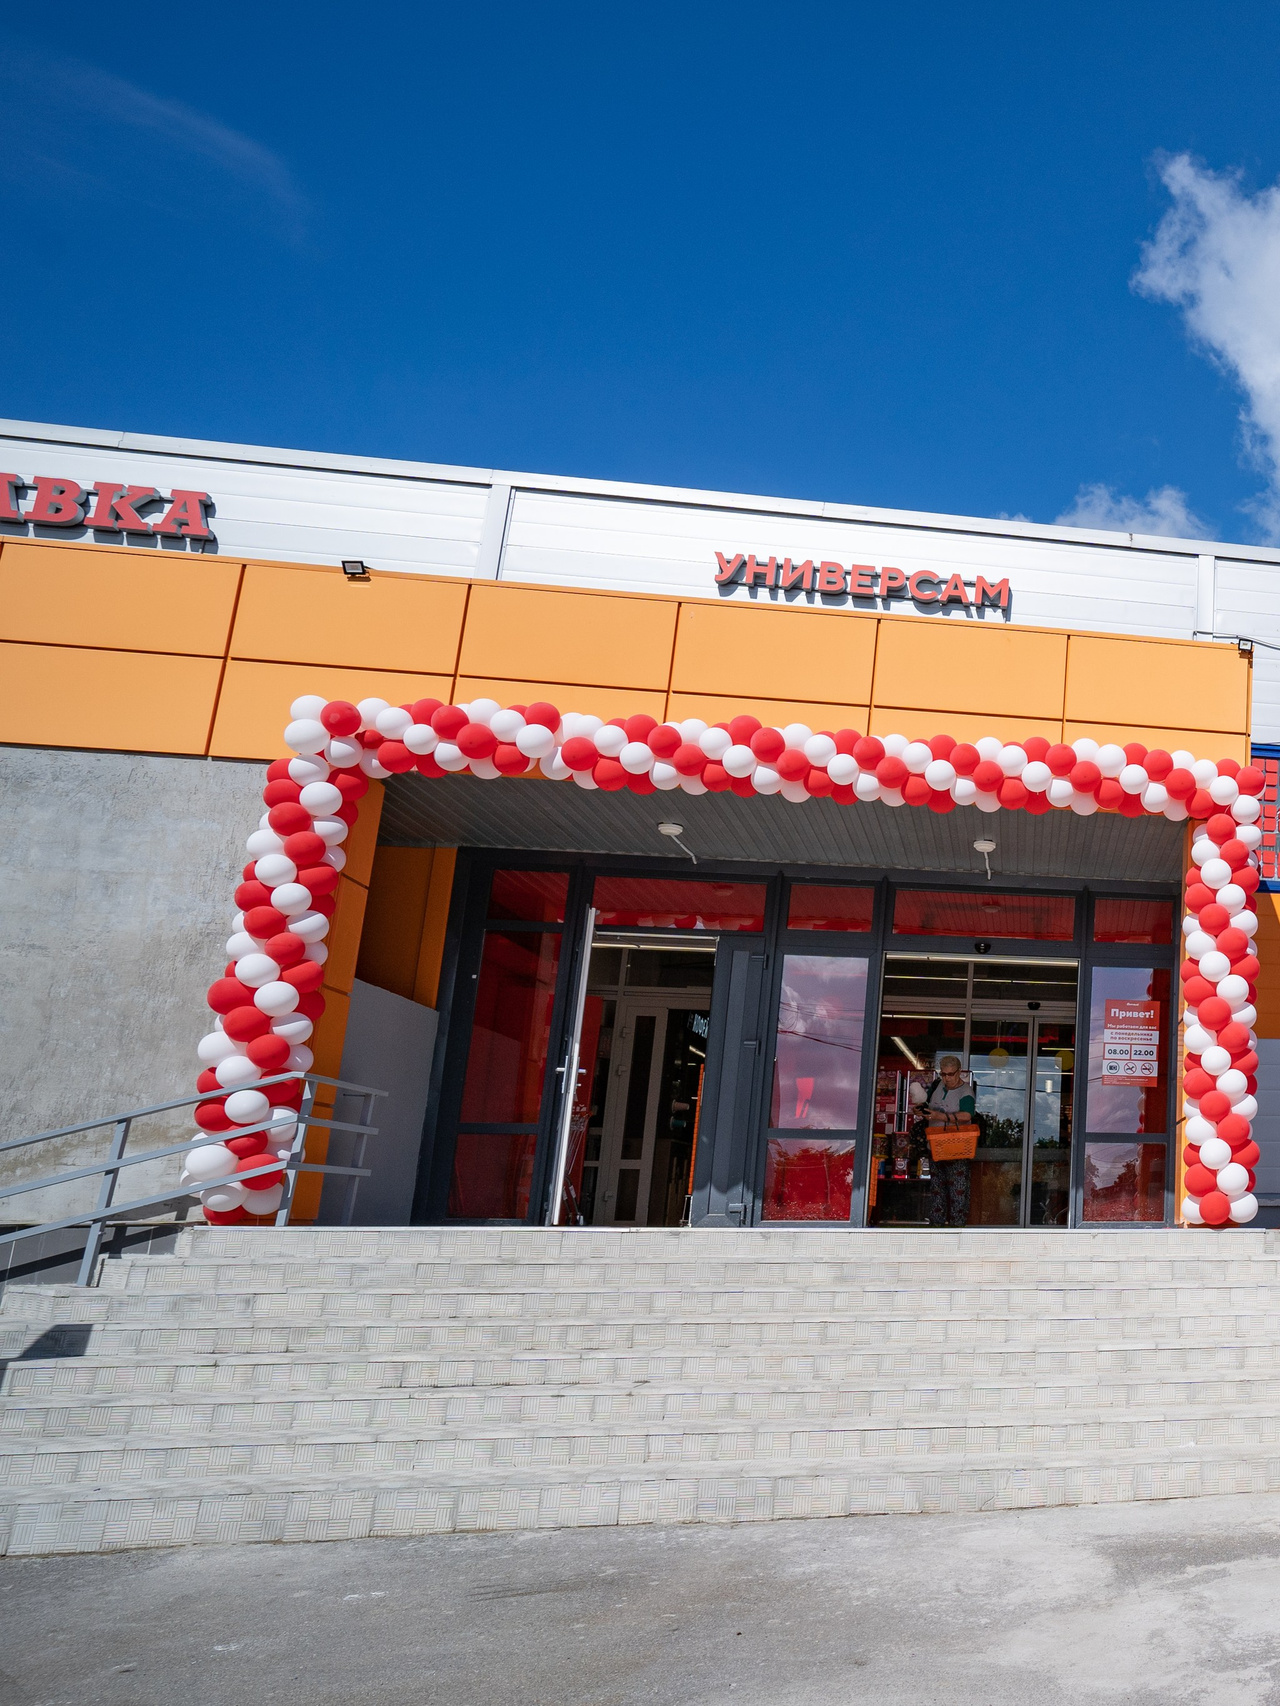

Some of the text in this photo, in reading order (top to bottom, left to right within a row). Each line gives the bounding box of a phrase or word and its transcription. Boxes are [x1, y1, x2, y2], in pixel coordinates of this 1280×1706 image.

[714, 551, 1010, 608] УНИВЕРСАМ
[1111, 1008, 1154, 1019] Привет!
[1107, 1048, 1154, 1057] 08.00 22.00
